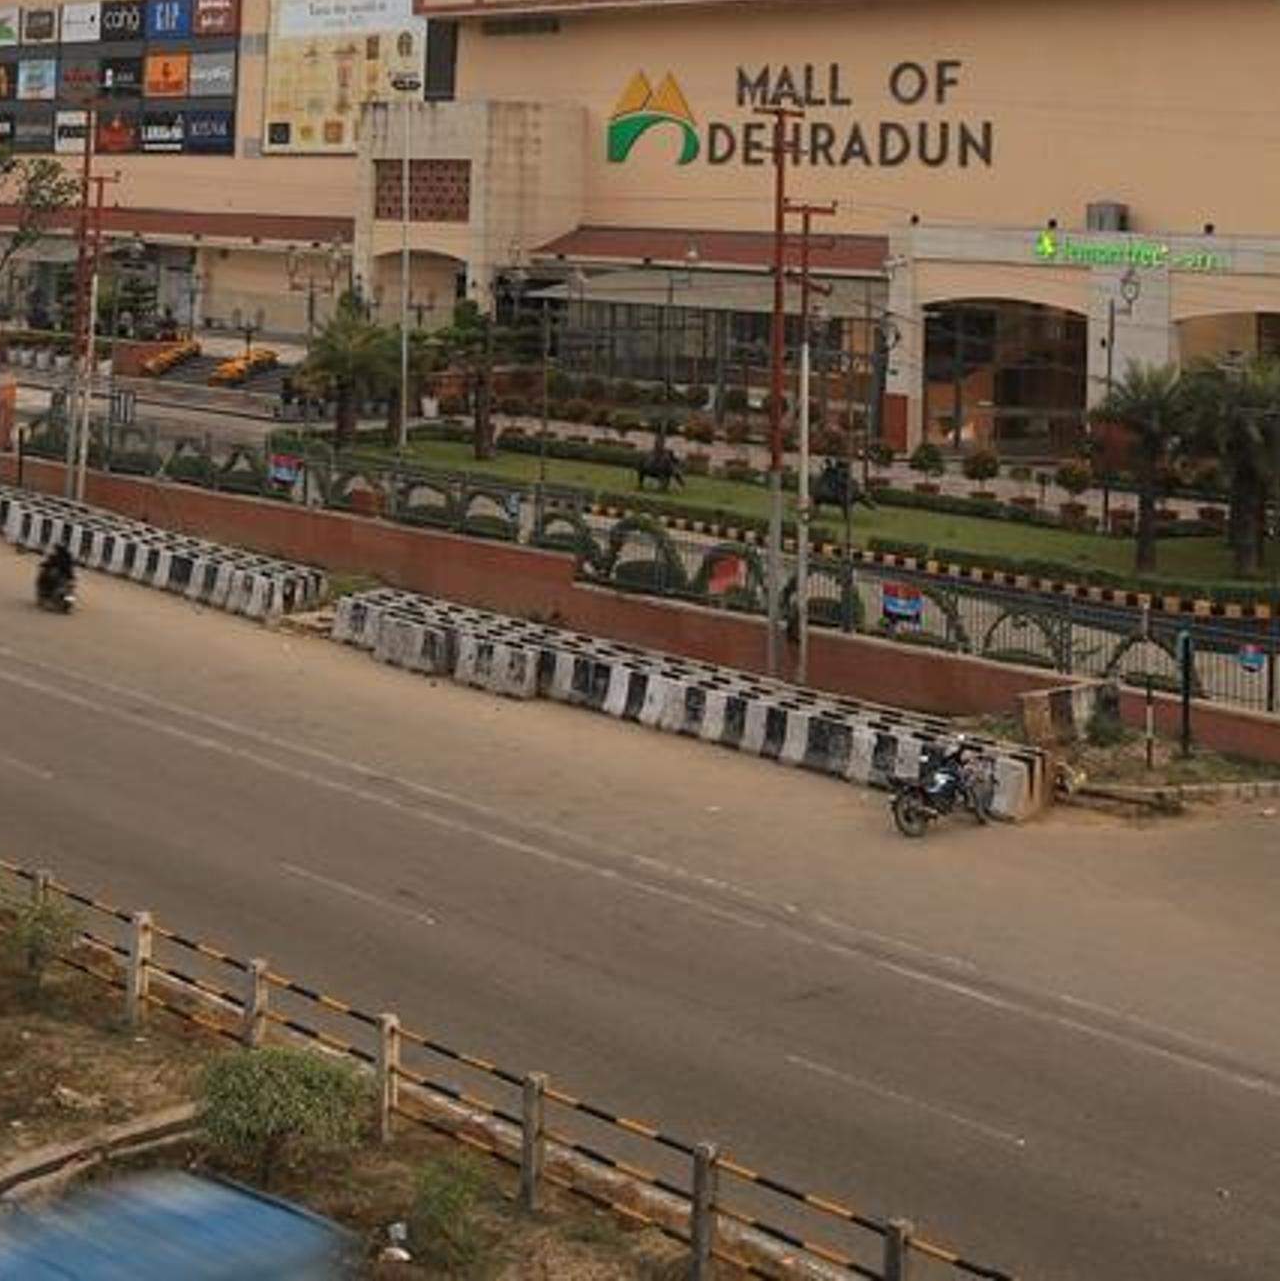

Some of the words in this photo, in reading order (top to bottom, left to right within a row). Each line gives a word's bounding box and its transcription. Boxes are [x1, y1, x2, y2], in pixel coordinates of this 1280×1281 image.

[737, 63, 851, 106] MALL
[889, 60, 961, 105] OF
[708, 121, 993, 167] DEHRADUN
